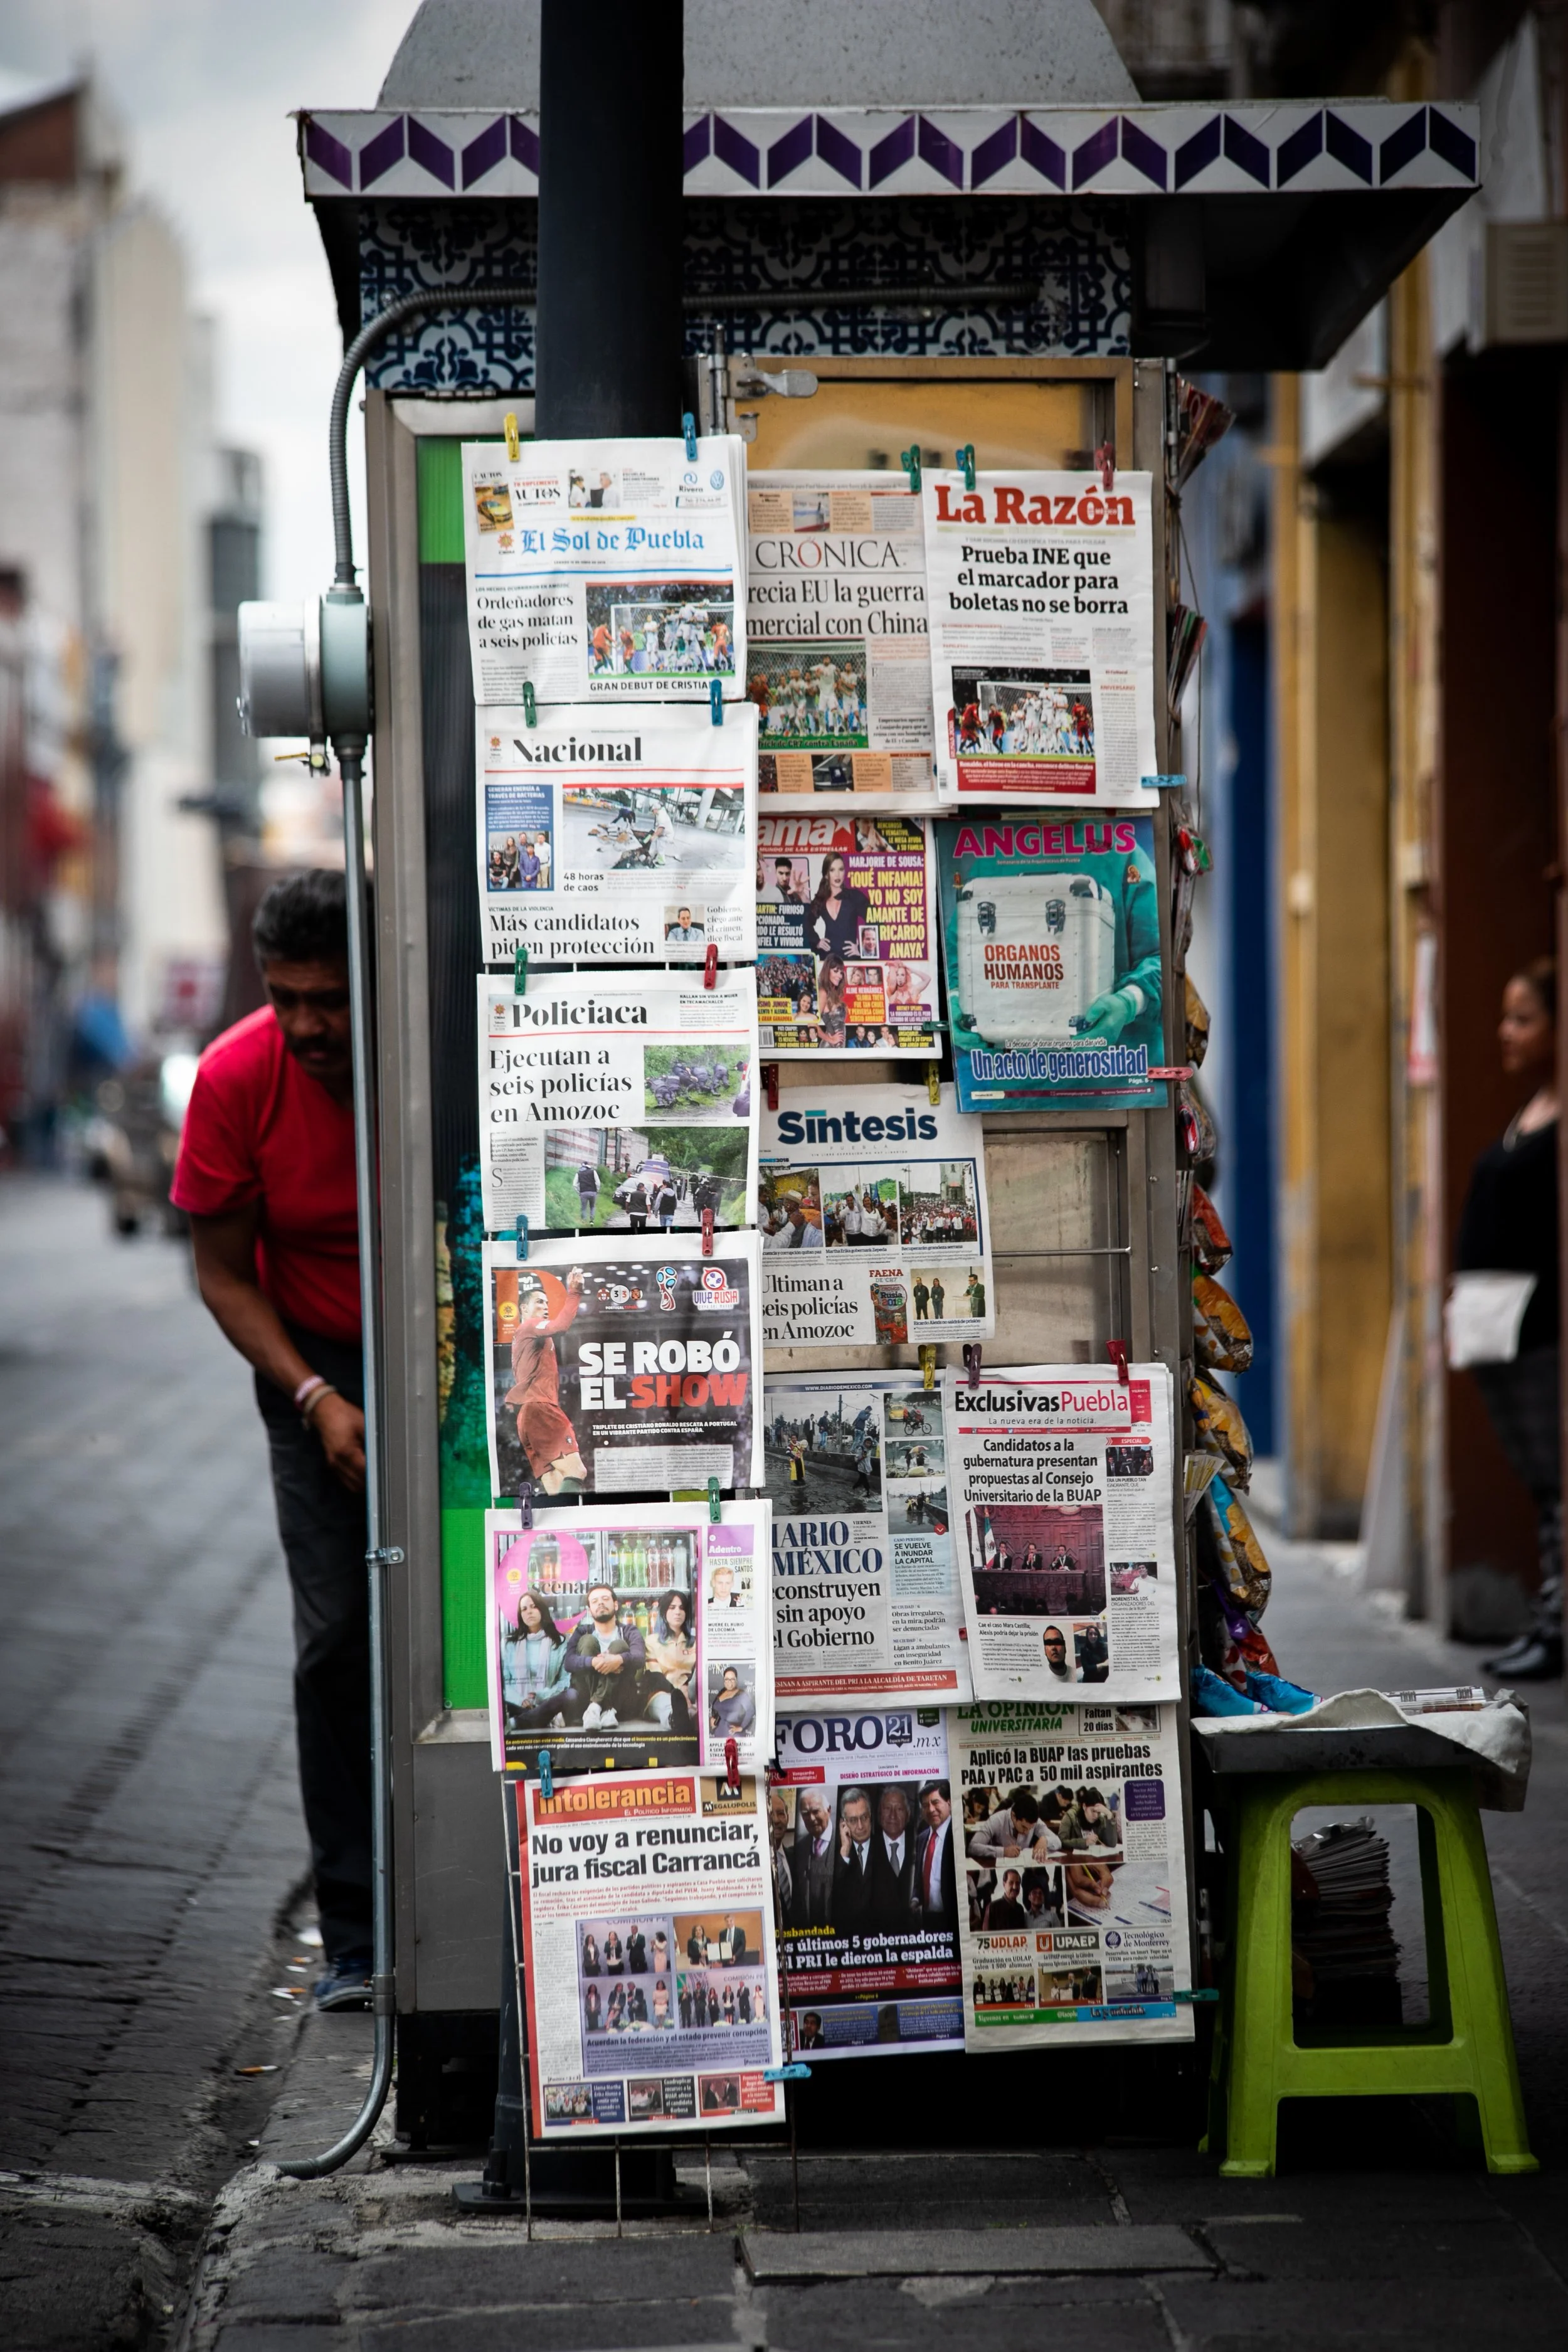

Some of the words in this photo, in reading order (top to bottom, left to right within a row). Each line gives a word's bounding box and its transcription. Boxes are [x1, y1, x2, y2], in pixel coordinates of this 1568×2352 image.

[935, 485, 986, 523] La
[993, 485, 1135, 526] Razón
[521, 529, 545, 555] El
[551, 527, 590, 552] Sol
[596, 530, 620, 550] de
[625, 526, 704, 551] Puebla
[961, 546, 1028, 564] Prueba
[1033, 548, 1069, 565] INE
[1074, 551, 1111, 569] que
[958, 569, 974, 586] el
[978, 571, 1069, 588] marcador
[1074, 575, 1118, 593] para
[477, 595, 573, 609] Ordeñadores
[801, 580, 829, 603] EU
[834, 578, 852, 602] la
[857, 585, 924, 608] guerra
[478, 617, 495, 629] de
[500, 618, 524, 632] gas
[528, 615, 573, 627] matan
[825, 618, 862, 635] con
[867, 610, 928, 635] China
[479, 639, 487, 649] a
[490, 635, 519, 648] seis
[522, 632, 578, 650] policías
[590, 682, 618, 691] GRAN
[621, 682, 654, 690] DEBUT
[656, 681, 668, 689] DE
[513, 737, 642, 763] Nacional
[953, 824, 1136, 857] ANGELUS
[849, 857, 885, 867] MARJORIE
[887, 857, 897, 867] DE
[898, 856, 924, 867] SOUSA:
[579, 872, 604, 881] horas
[868, 889, 882, 905] YO
[885, 889, 901, 904] NO
[903, 889, 923, 904] SOY
[490, 914, 527, 931] Más
[534, 914, 639, 931] candidatos
[866, 908, 907, 923] AMANTE
[911, 908, 924, 922] DE
[879, 924, 924, 940] RICARDO
[550, 937, 654, 958] protección
[984, 945, 1061, 961] ORGANOS
[984, 963, 1064, 980] HUMANOS
[991, 982, 1009, 990] PARA
[1012, 981, 1059, 989] TRANSPLANTE
[512, 1000, 647, 1028] Policiaca
[489, 1049, 590, 1073] Ejecutan
[598, 1051, 610, 1064] a
[972, 1050, 993, 1079] Un
[994, 1051, 1027, 1079] acto
[1029, 1049, 1047, 1078] de
[1049, 1045, 1147, 1082] generosidad
[490, 1076, 534, 1097] seis
[541, 1074, 632, 1098] policías
[490, 1105, 517, 1123] en
[526, 1103, 620, 1121] Amozoc
[881, 1291, 902, 1300] Rusia
[882, 1298, 903, 1306] 2018
[792, 1296, 858, 1320] policías
[783, 1321, 854, 1339] Amozoc
[578, 1342, 626, 1375] SE
[633, 1332, 740, 1374] ROBÓ
[581, 1377, 626, 1410] EL
[632, 1374, 748, 1409] SHOW
[955, 1389, 1128, 1411] ExclusivasPuebla
[983, 1439, 1051, 1451] Candidatos
[1054, 1443, 1062, 1451] a
[1064, 1438, 1074, 1451] la
[963, 1455, 1034, 1470] gubernatura
[1037, 1456, 1098, 1470] presentan
[969, 1473, 1029, 1486] propuestas
[1032, 1472, 1043, 1485] al
[1046, 1471, 1093, 1486] Consejo
[709, 1545, 741, 1554] Adentro
[773, 1548, 882, 1576] MÉXICO
[776, 1604, 804, 1623] sin
[808, 1606, 866, 1626] apoyo
[787, 1628, 875, 1648] Gobierno
[1084, 1708, 1111, 1718] Faltan
[889, 1716, 910, 1736] 21
[972, 1717, 1062, 1734] UNIVERSITARIA
[1084, 1722, 1094, 1731] 20
[1095, 1722, 1113, 1731] días
[775, 1716, 883, 1756] FORO
[970, 1748, 1011, 1767] Aplicó
[1014, 1748, 1027, 1764] la
[1030, 1746, 1064, 1763] BUAP
[1067, 1746, 1088, 1761] las
[1092, 1744, 1150, 1761] pruebas
[539, 1781, 692, 1814] intolerancia
[532, 1834, 563, 1855] No
[568, 1833, 609, 1855] voy
[615, 1832, 629, 1848] a
[636, 1820, 759, 1846] renunciar,
[531, 1862, 579, 1888] jura
[584, 1853, 647, 1879] fiscal
[652, 1846, 761, 1873] Carrancá
[797, 1937, 849, 1952] últimos
[852, 1936, 860, 1948] 5
[863, 1931, 953, 1951] gobernadores
[1056, 1936, 1096, 1949] UPAEP
[1134, 1939, 1170, 1948] Monterrey
